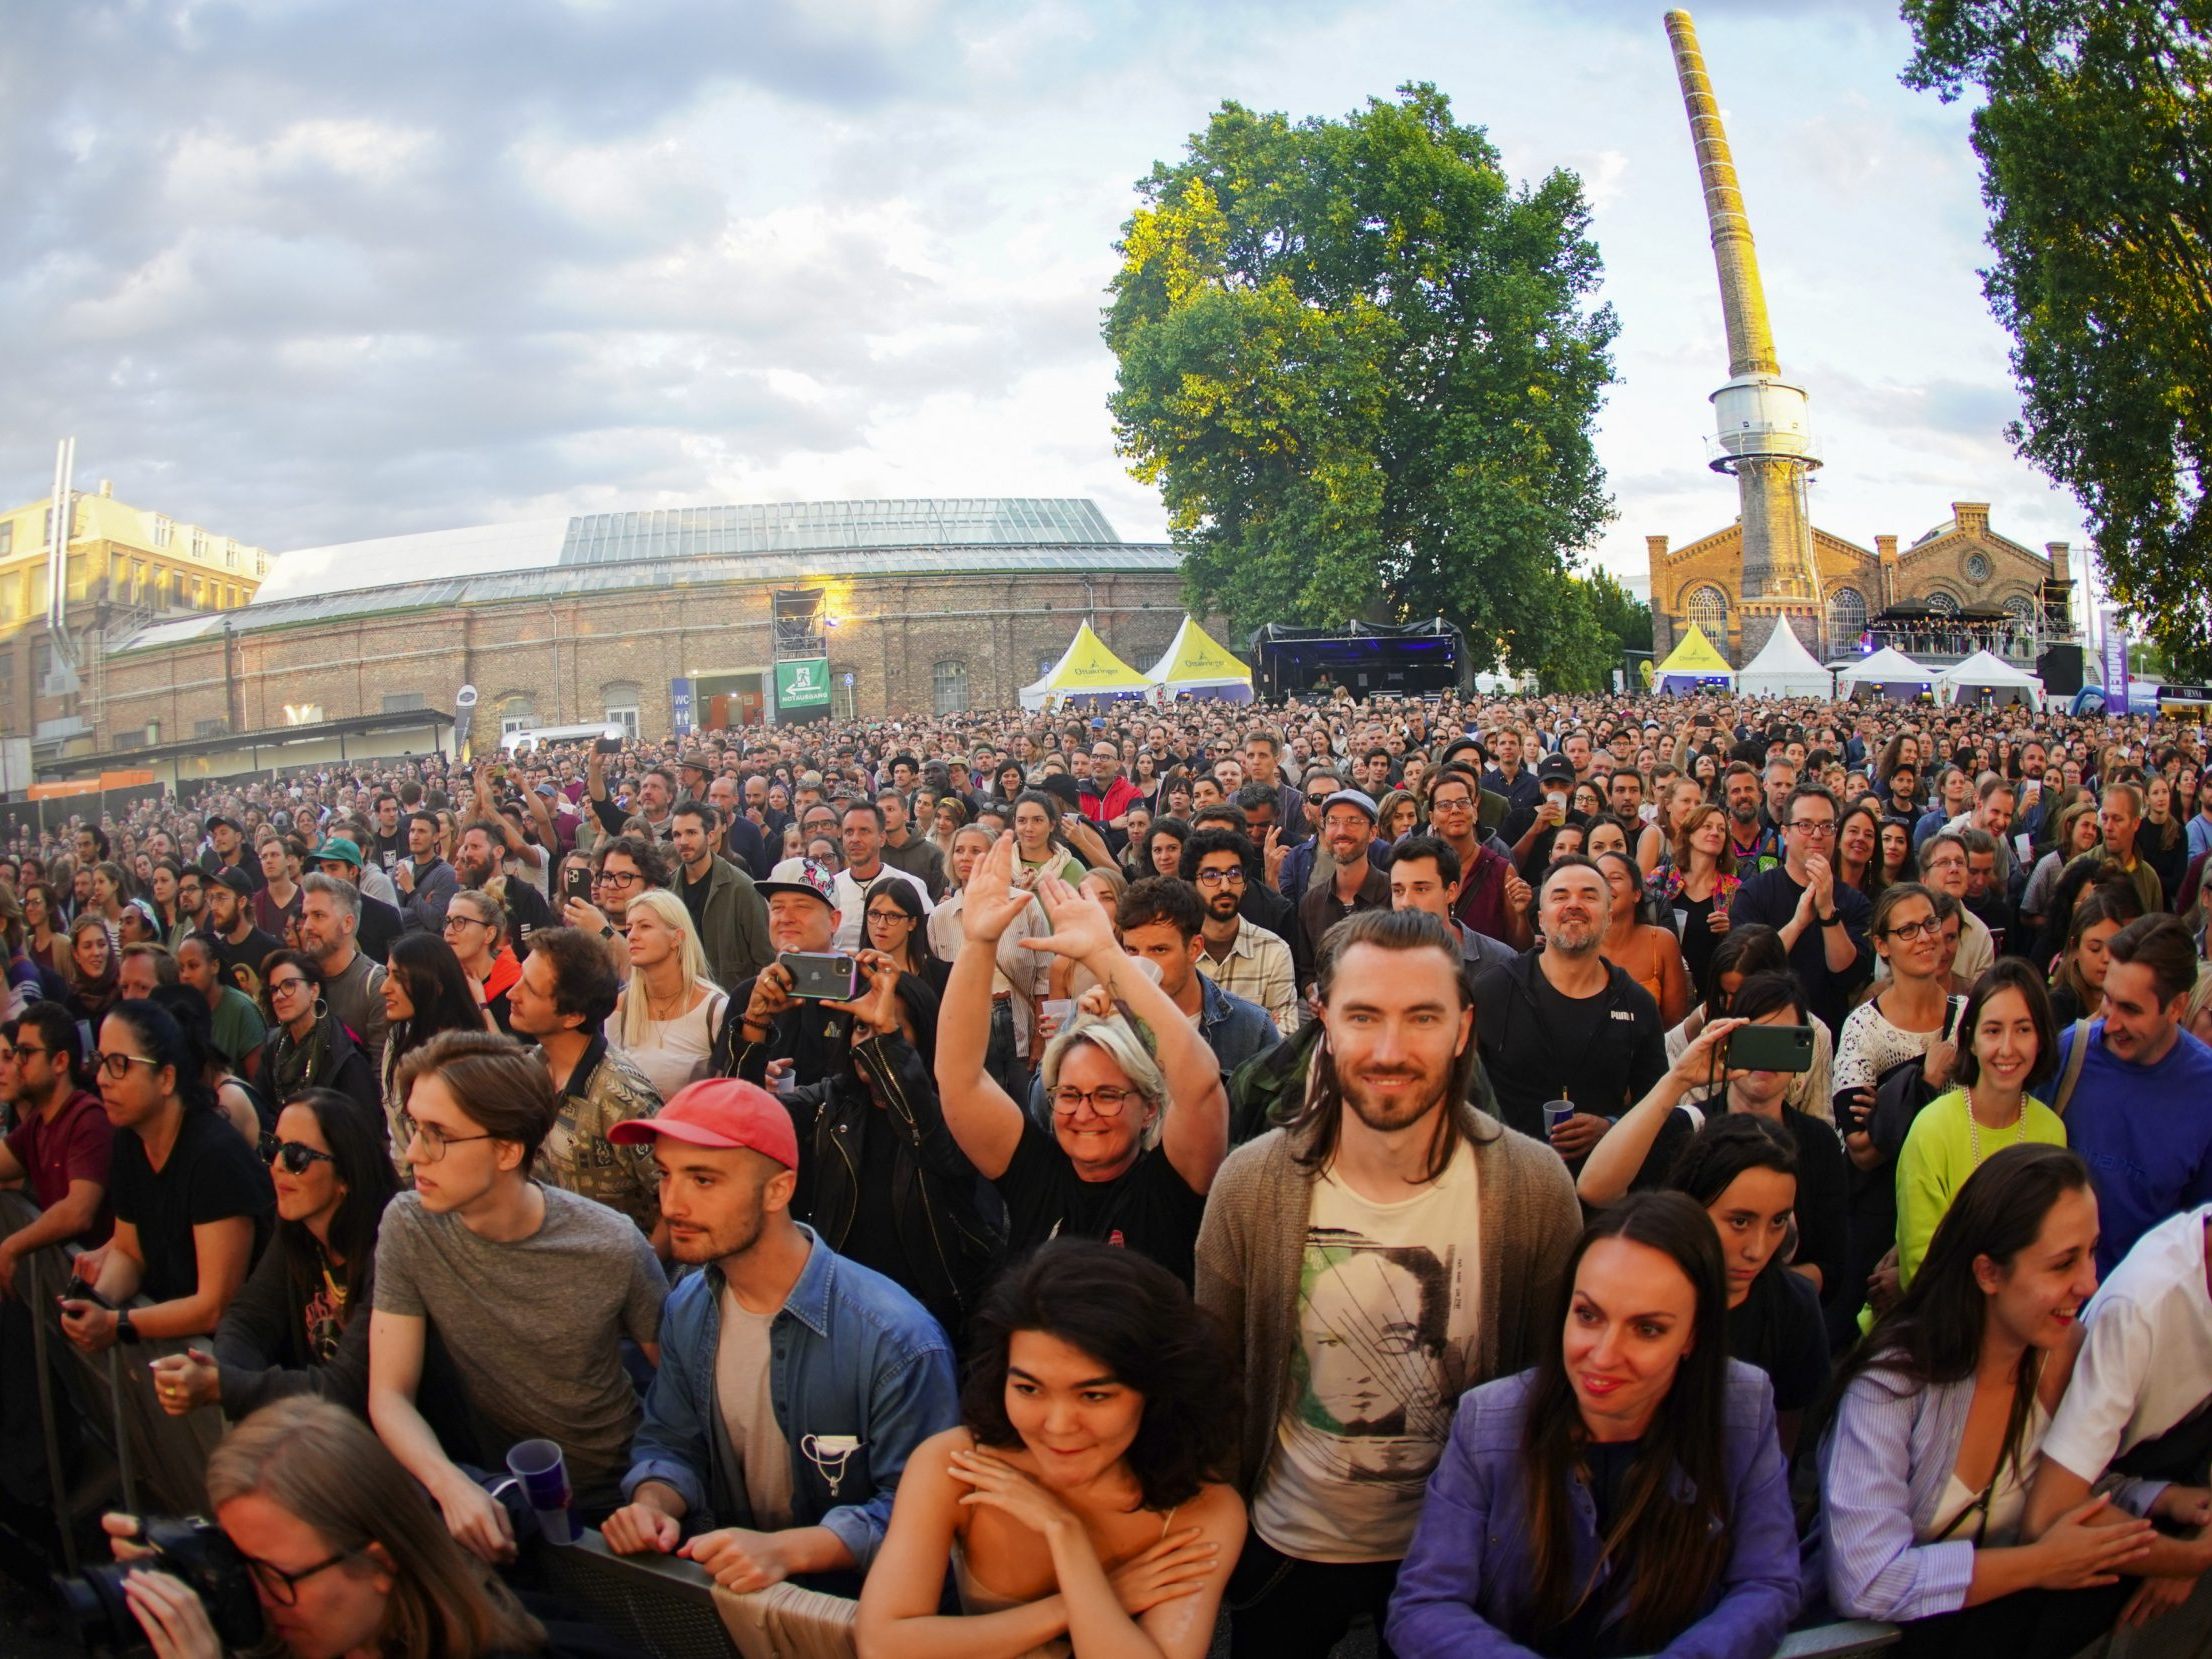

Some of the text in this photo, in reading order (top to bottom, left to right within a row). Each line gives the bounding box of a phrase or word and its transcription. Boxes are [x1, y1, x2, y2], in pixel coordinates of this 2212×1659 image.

[1074, 667, 1119, 676] Ottakringer
[782, 692, 828, 702] NOTAUSGANG
[2183, 688, 2203, 699] VIENNA
[674, 694, 690, 705] WC
